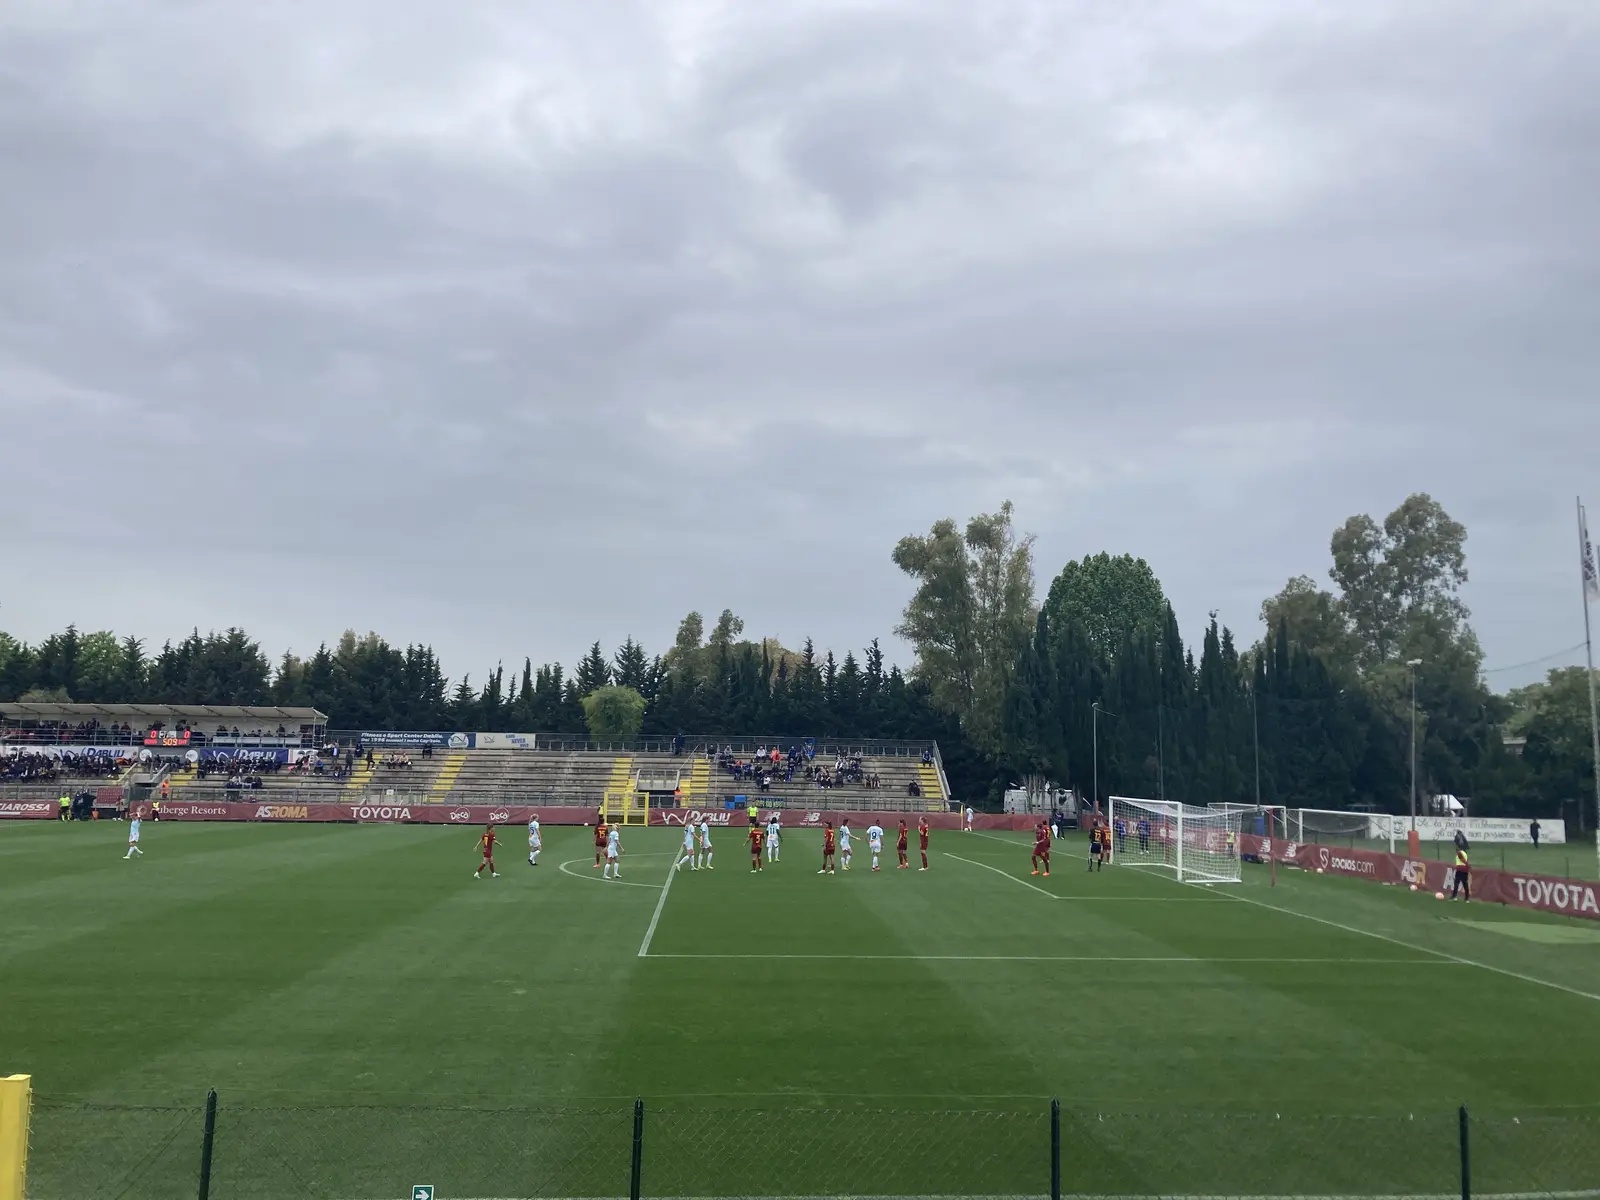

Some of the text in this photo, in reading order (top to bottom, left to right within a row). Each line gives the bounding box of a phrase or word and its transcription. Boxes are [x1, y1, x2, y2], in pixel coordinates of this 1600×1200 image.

[150, 730, 157, 738] 0
[184, 730, 191, 739] 0
[150, 805, 227, 816] uberge Resorts
[351, 807, 411, 819] TOYOTA
[871, 831, 878, 840] 9
[1331, 857, 1376, 875] socios.com
[1513, 878, 1600, 914] TOYOTA
